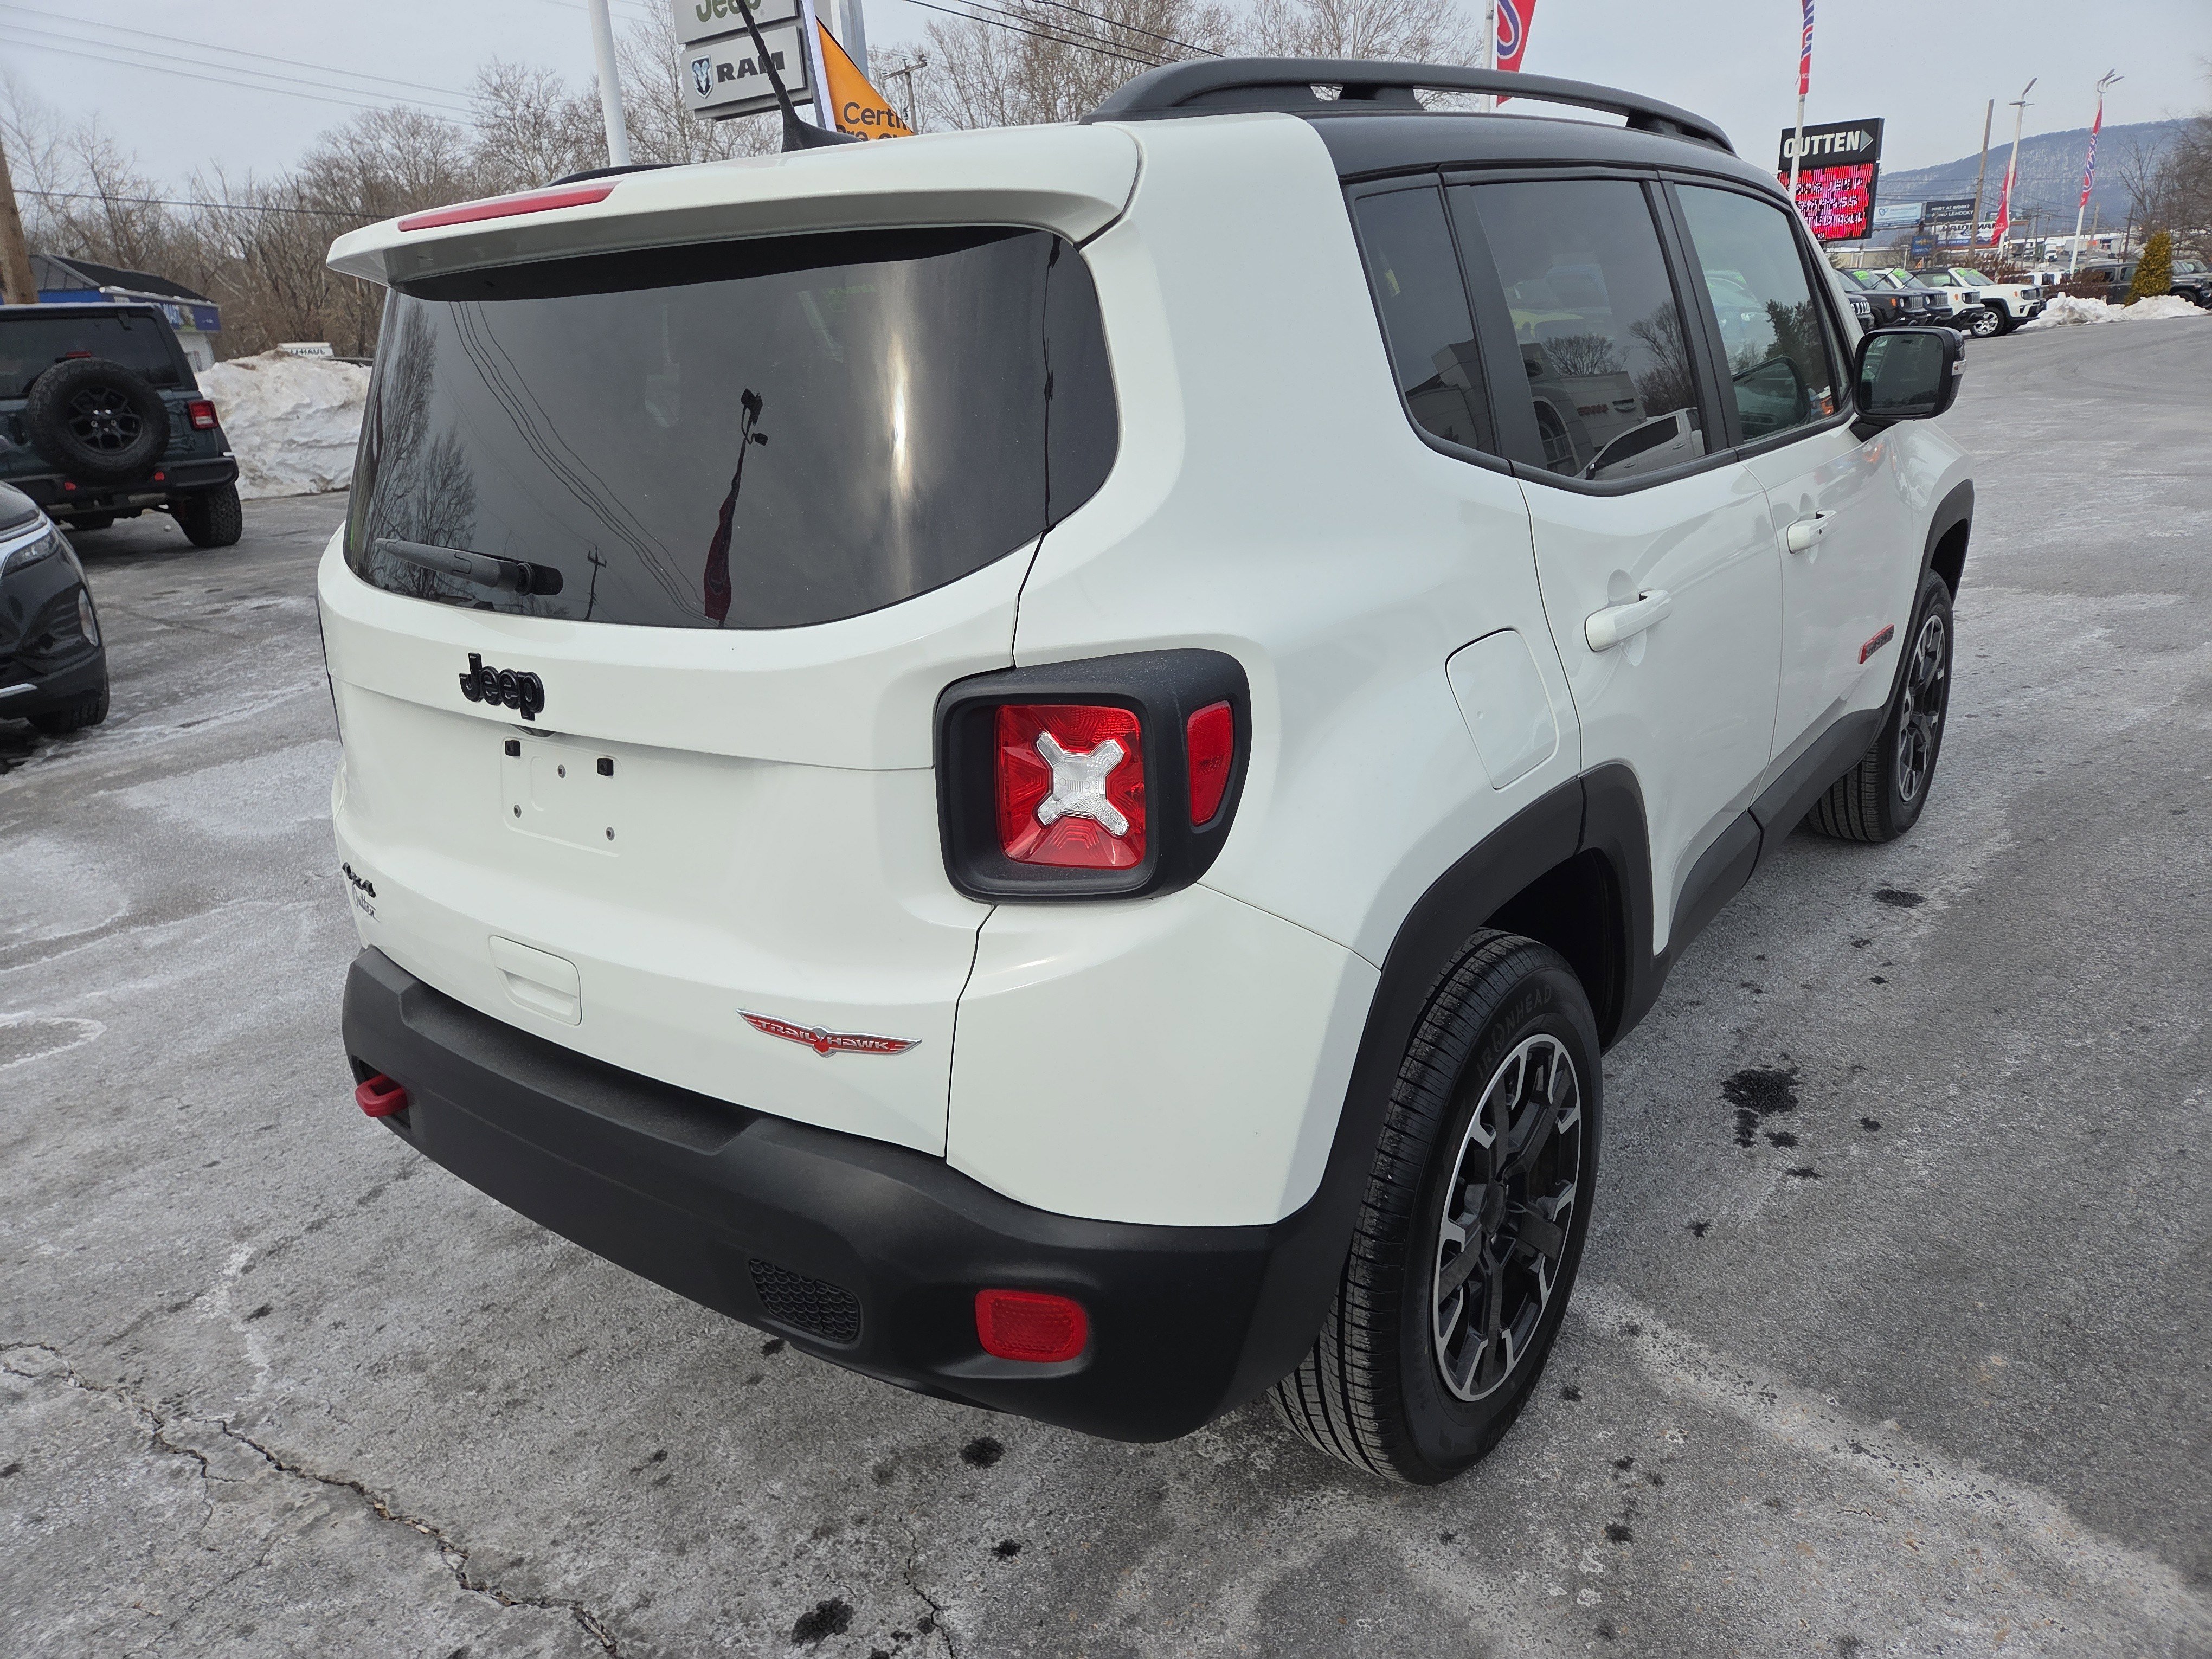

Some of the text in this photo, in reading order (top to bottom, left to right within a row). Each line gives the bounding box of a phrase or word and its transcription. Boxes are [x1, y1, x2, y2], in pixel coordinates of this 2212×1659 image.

[716, 51, 785, 83] RAM
[1783, 130, 1860, 158] OUTTEN
[459, 652, 545, 721] Jeep
[1476, 984, 1552, 1079] IRONHEAD
